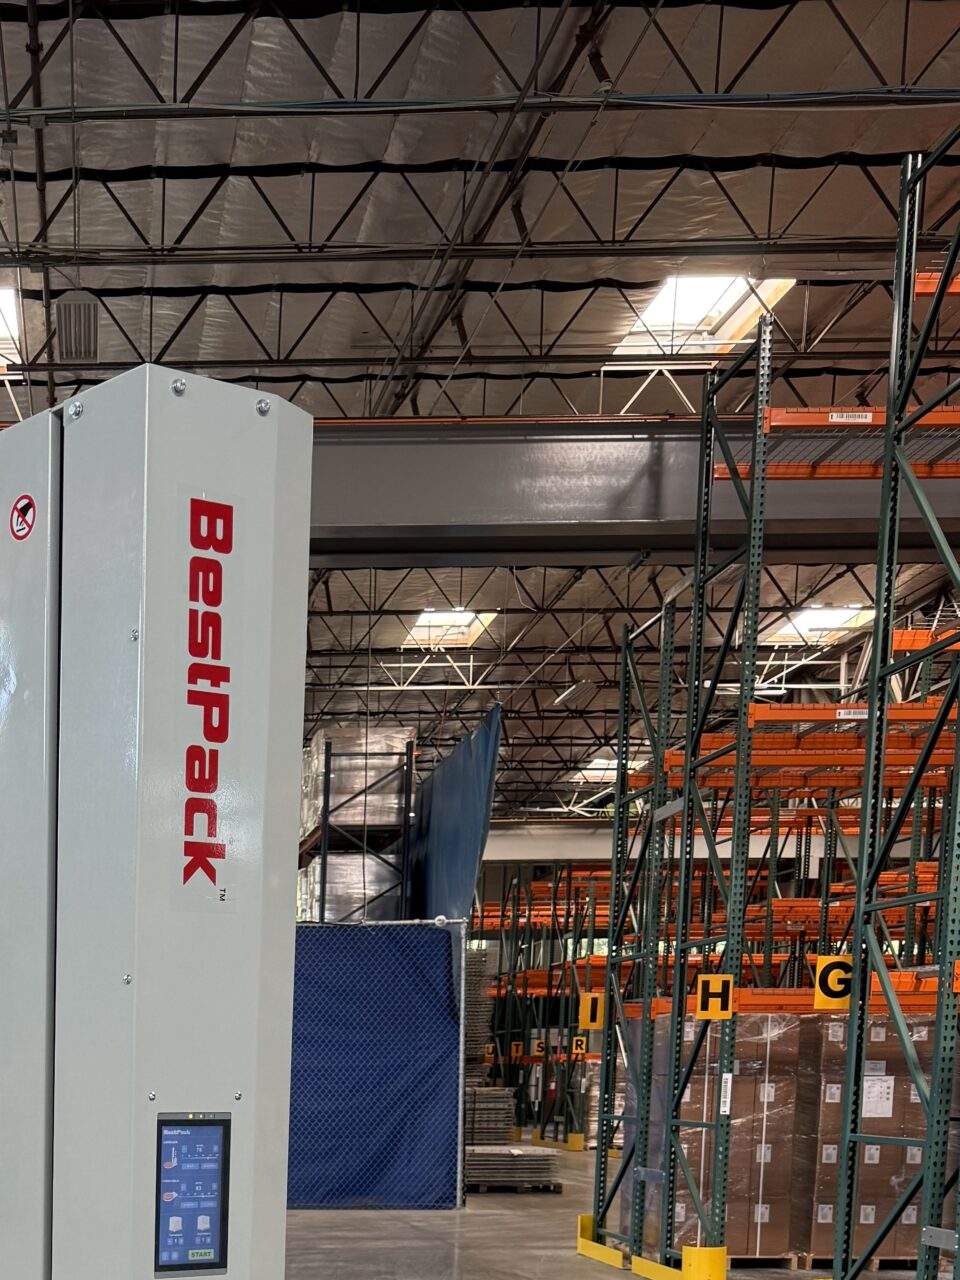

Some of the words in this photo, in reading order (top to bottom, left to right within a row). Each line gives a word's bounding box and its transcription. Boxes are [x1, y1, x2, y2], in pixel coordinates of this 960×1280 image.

[183, 497, 234, 886] BestPack
[818, 961, 852, 998] G
[699, 979, 730, 1012] H
[590, 996, 598, 1023] I
[514, 1044, 521, 1053] T
[536, 1042, 545, 1052] S
[575, 1038, 584, 1050] R
